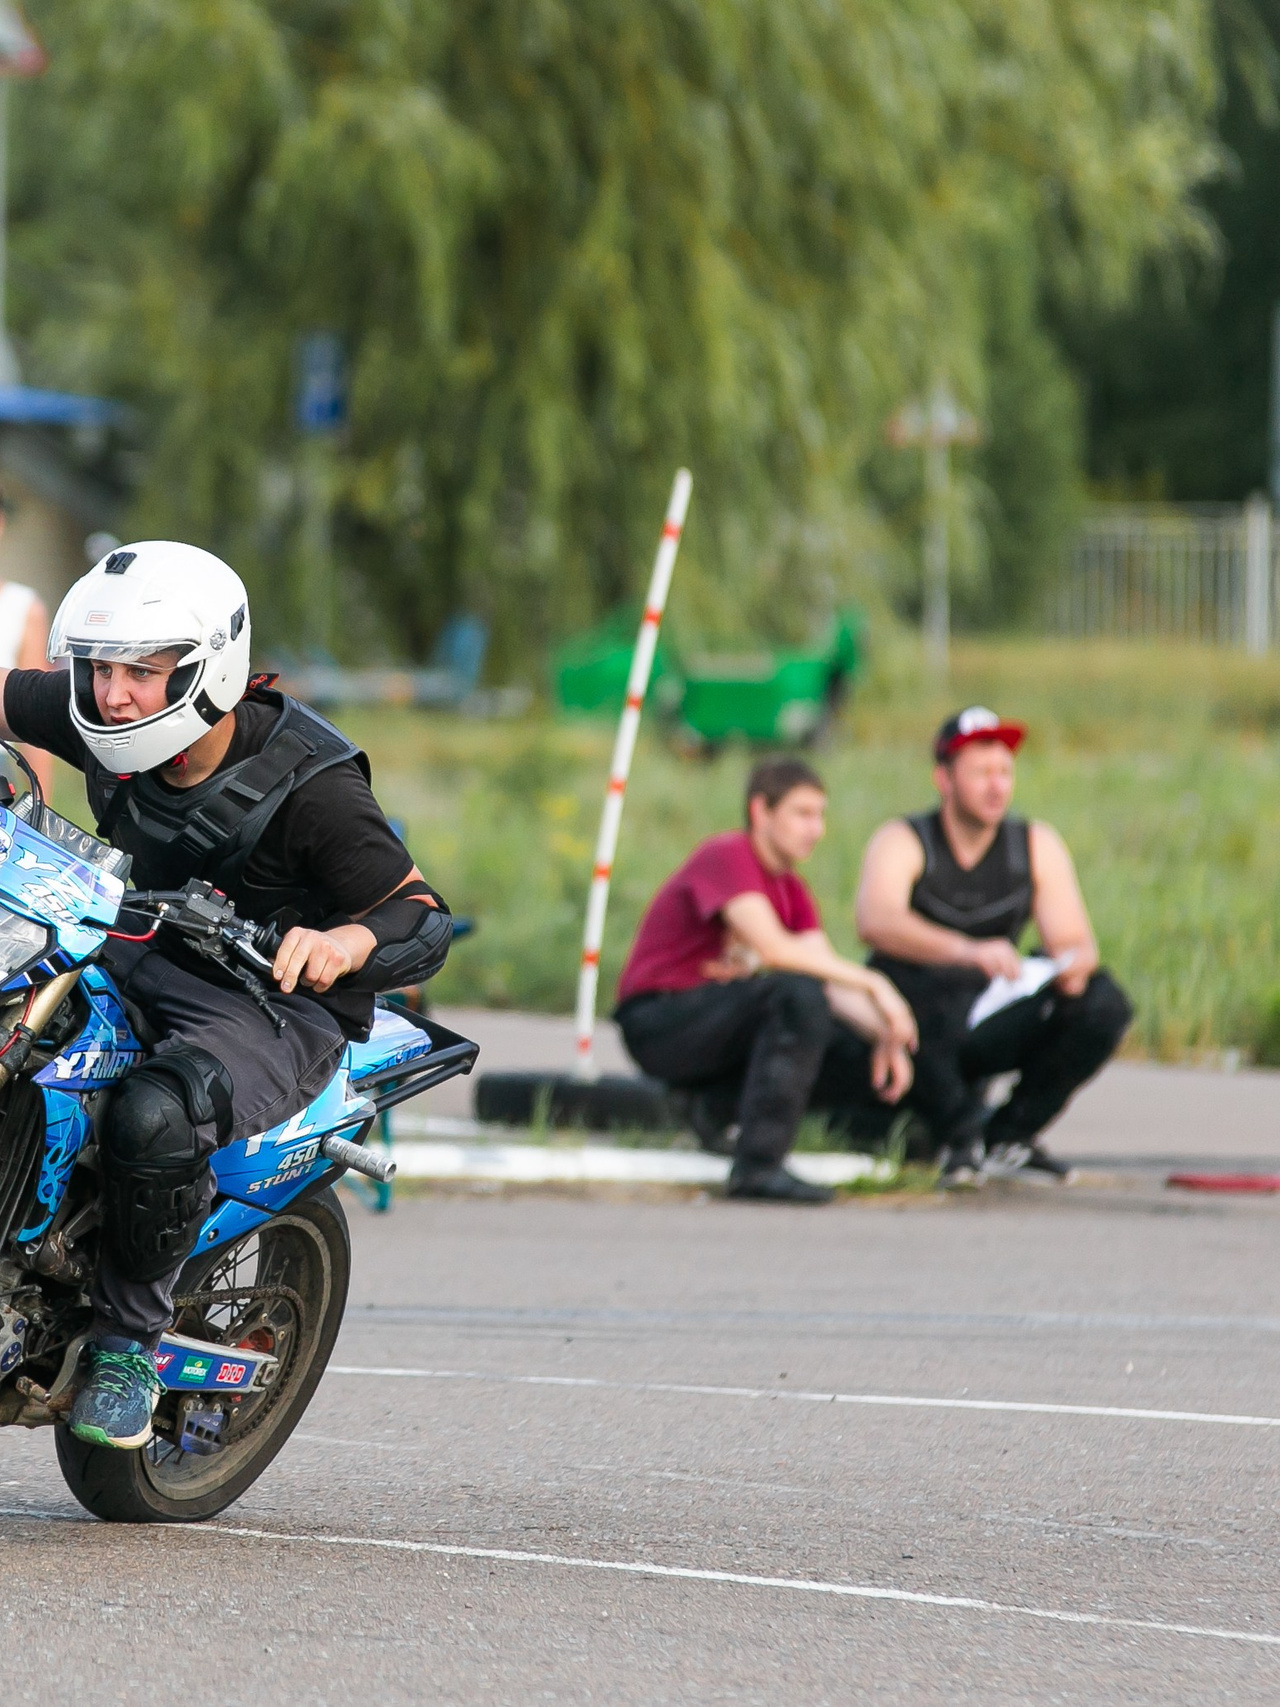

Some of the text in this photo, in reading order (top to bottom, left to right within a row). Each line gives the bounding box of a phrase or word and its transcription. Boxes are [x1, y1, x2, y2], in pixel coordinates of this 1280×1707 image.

[22, 883, 81, 925] 450
[53, 1051, 147, 1080] YAMAH
[276, 1142, 320, 1171] 450
[245, 1160, 317, 1195] STUNT
[216, 1362, 247, 1384] DID
